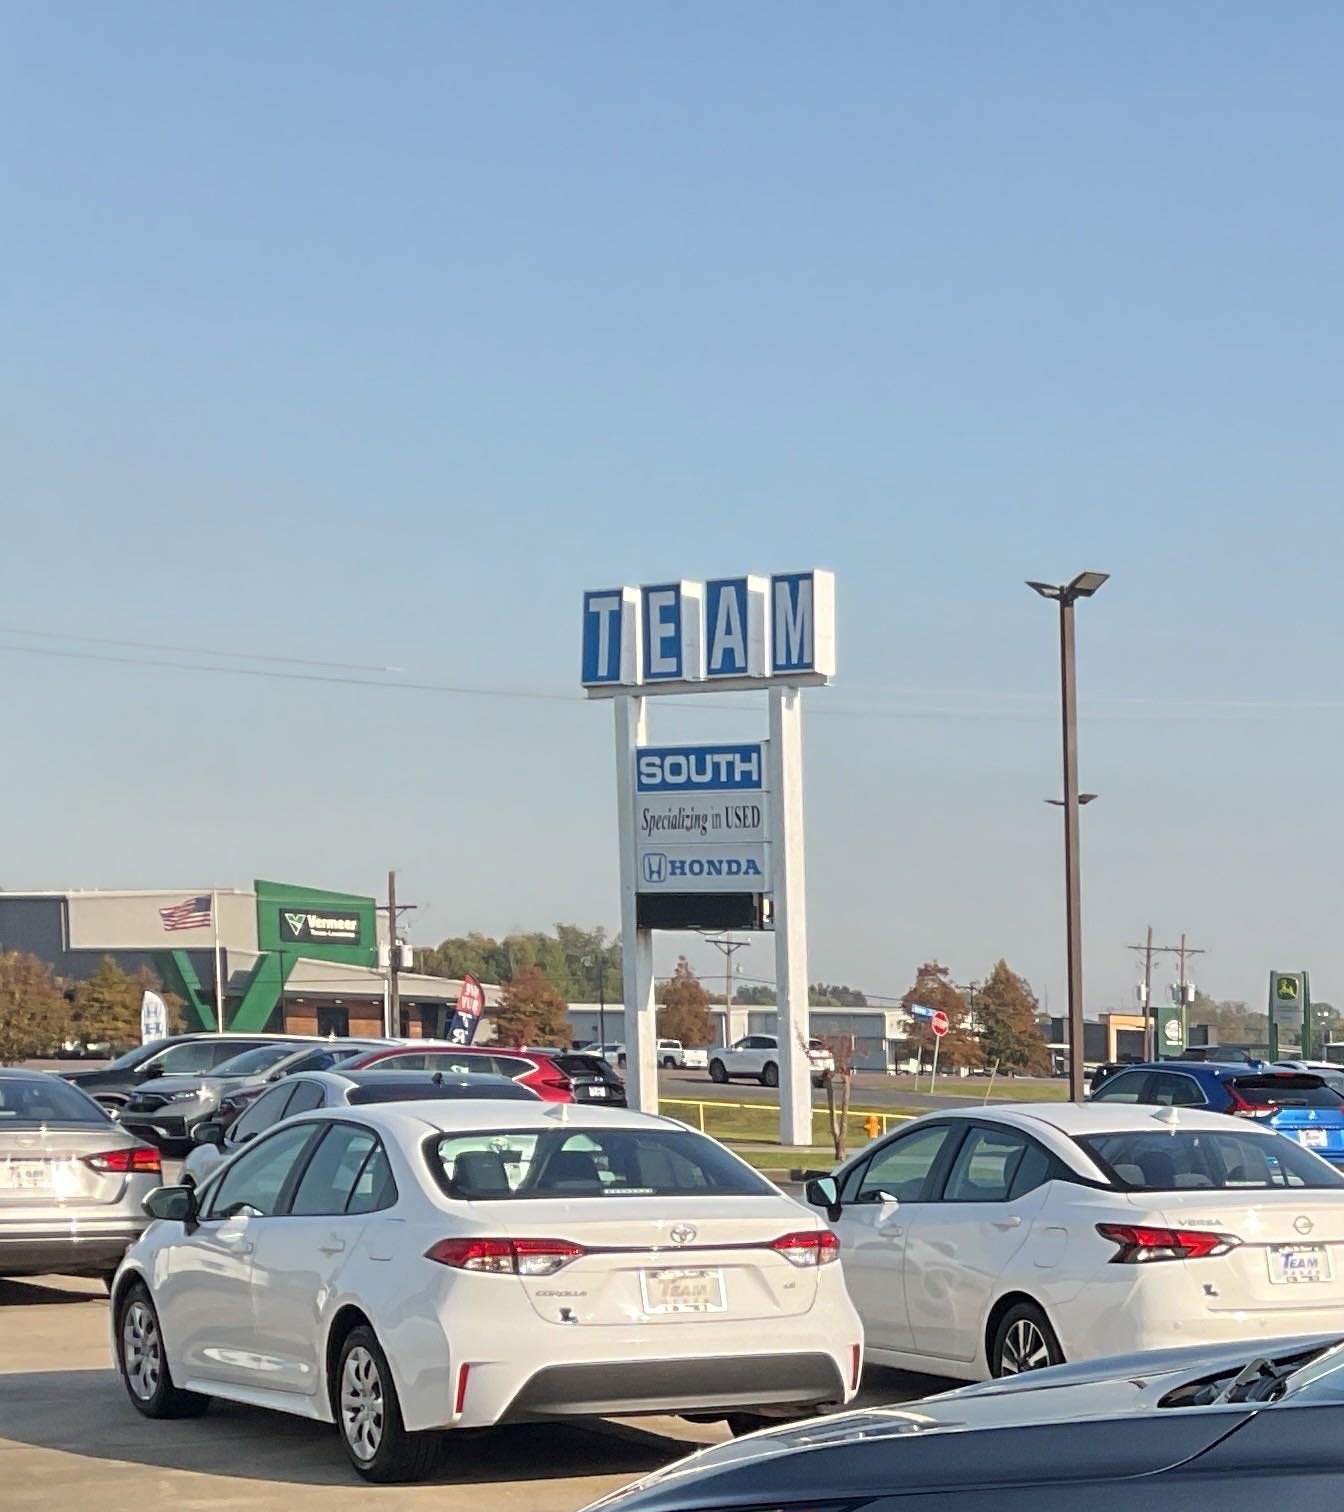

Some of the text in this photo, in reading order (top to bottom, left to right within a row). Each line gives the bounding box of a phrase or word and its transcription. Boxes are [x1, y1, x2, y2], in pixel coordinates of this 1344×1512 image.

[588, 579, 812, 678] TEAM
[640, 753, 759, 784] SOUTH
[641, 806, 761, 837] Specializing in USED
[669, 859, 762, 876] HONDA
[306, 914, 357, 931] Vermeer
